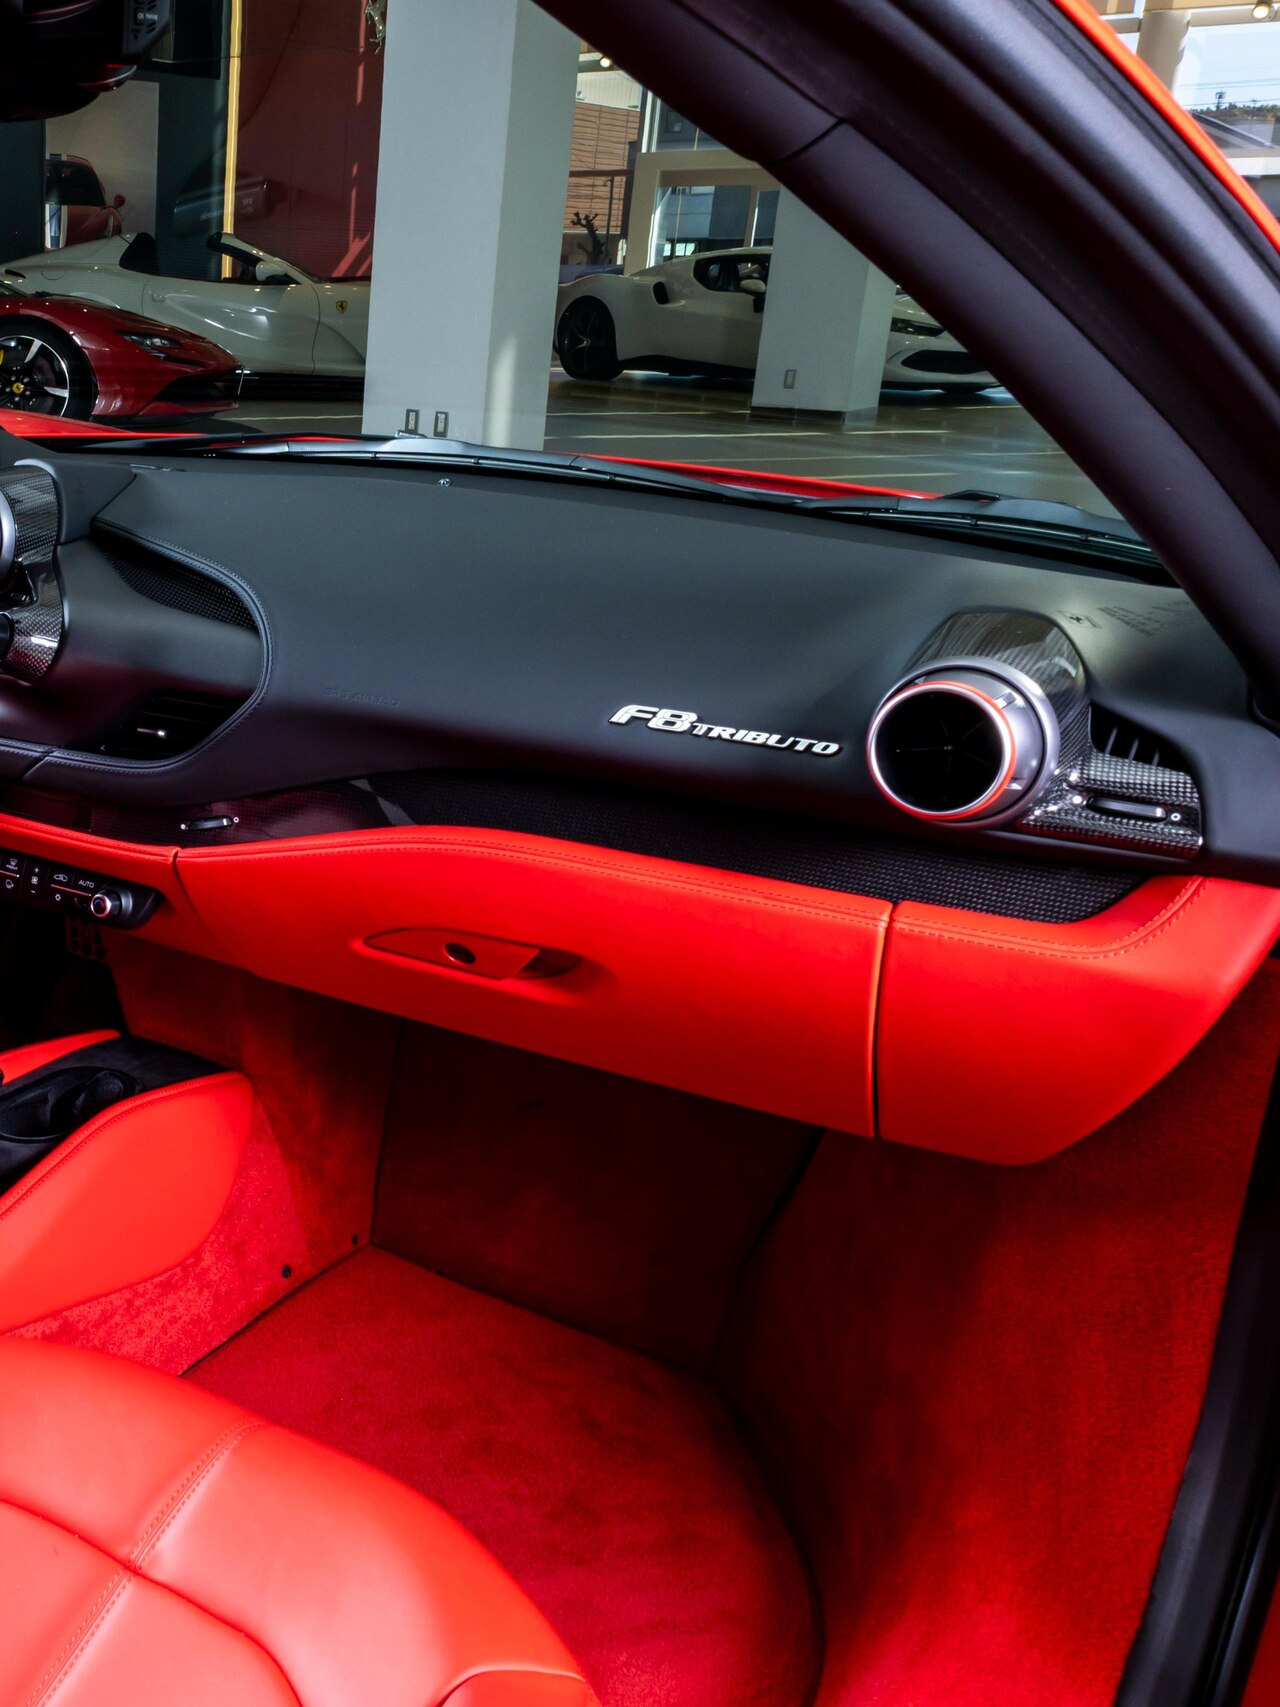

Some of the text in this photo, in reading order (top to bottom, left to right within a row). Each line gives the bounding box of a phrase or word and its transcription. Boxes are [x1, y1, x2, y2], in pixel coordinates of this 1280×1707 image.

[608, 704, 840, 755] F8 TRIBUTO
[78, 879, 95, 889] AUTO
